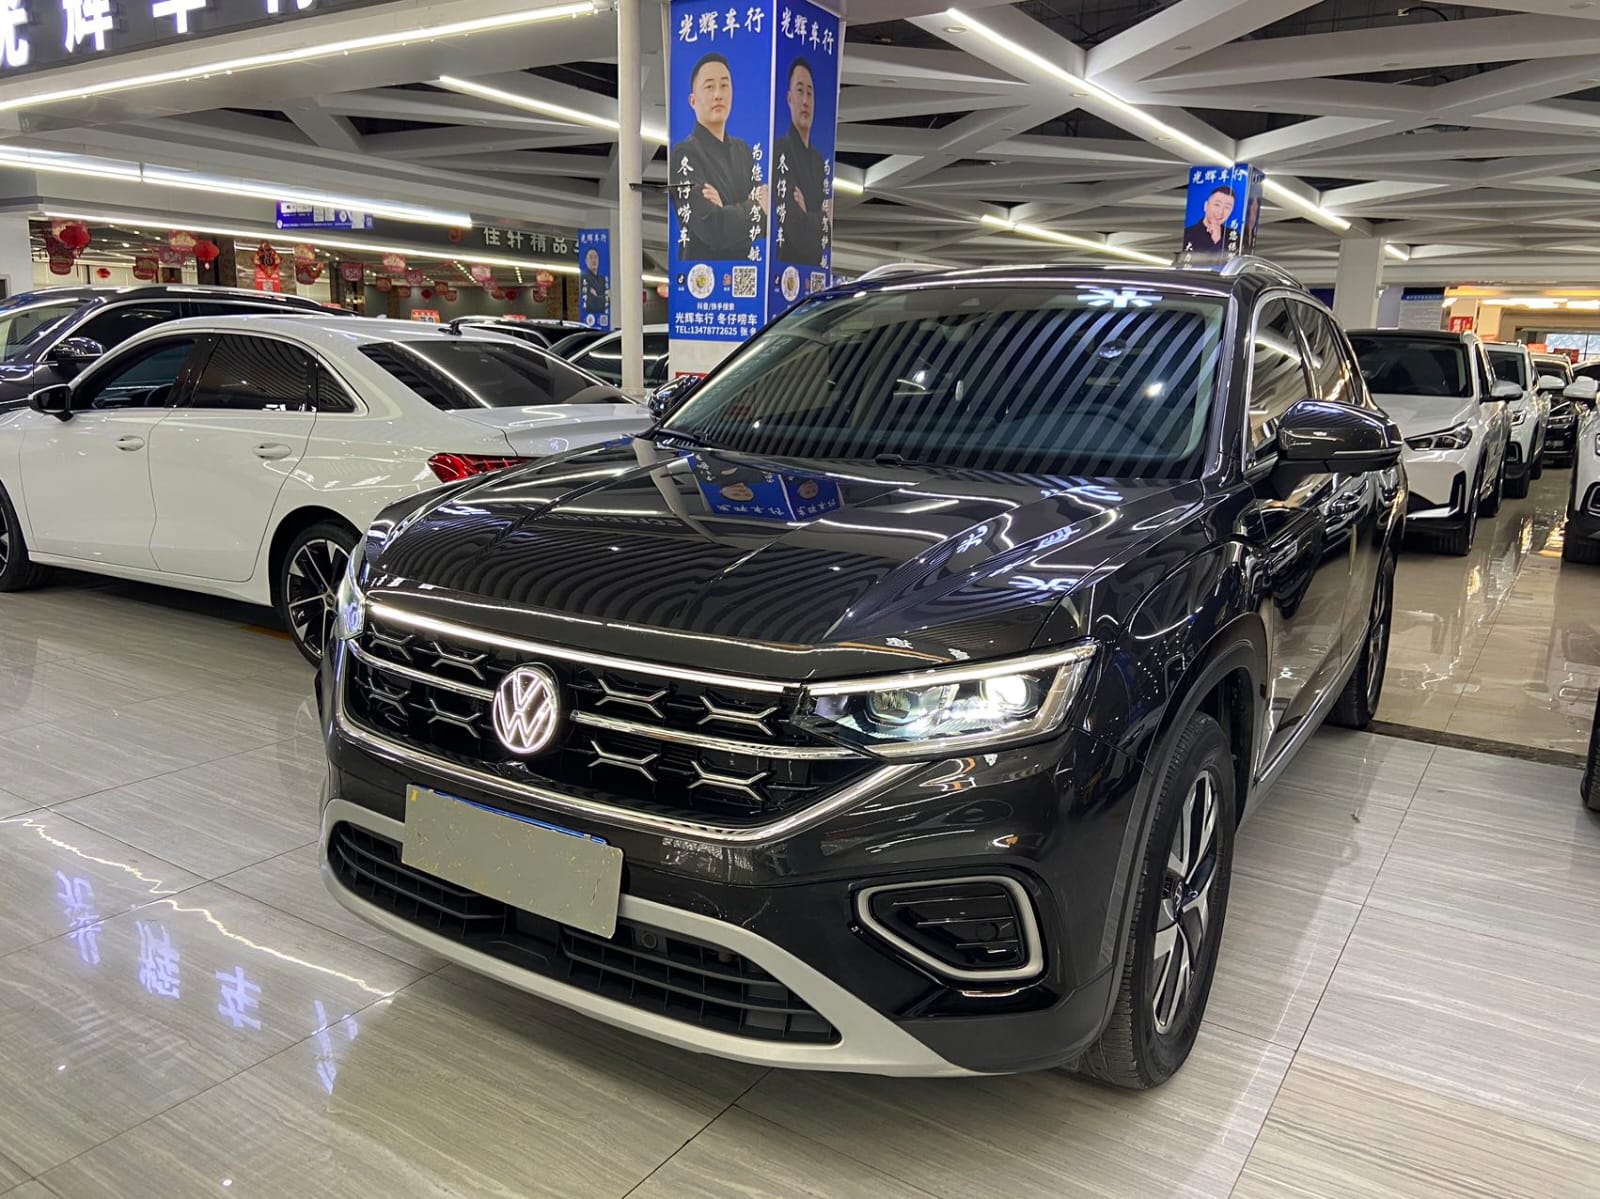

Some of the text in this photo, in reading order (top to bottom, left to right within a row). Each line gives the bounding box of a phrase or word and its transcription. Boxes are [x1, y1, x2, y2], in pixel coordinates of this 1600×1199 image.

[678, 7, 765, 42] 光辉车行
[780, 6, 835, 55] 光辉车行
[677, 155, 694, 248] 冬仔唠车
[747, 142, 764, 262] 为您保驾护航
[675, 312, 758, 326] 光辉车行 冬仔唠车
[675, 326, 738, 336] TEL:13478772625
